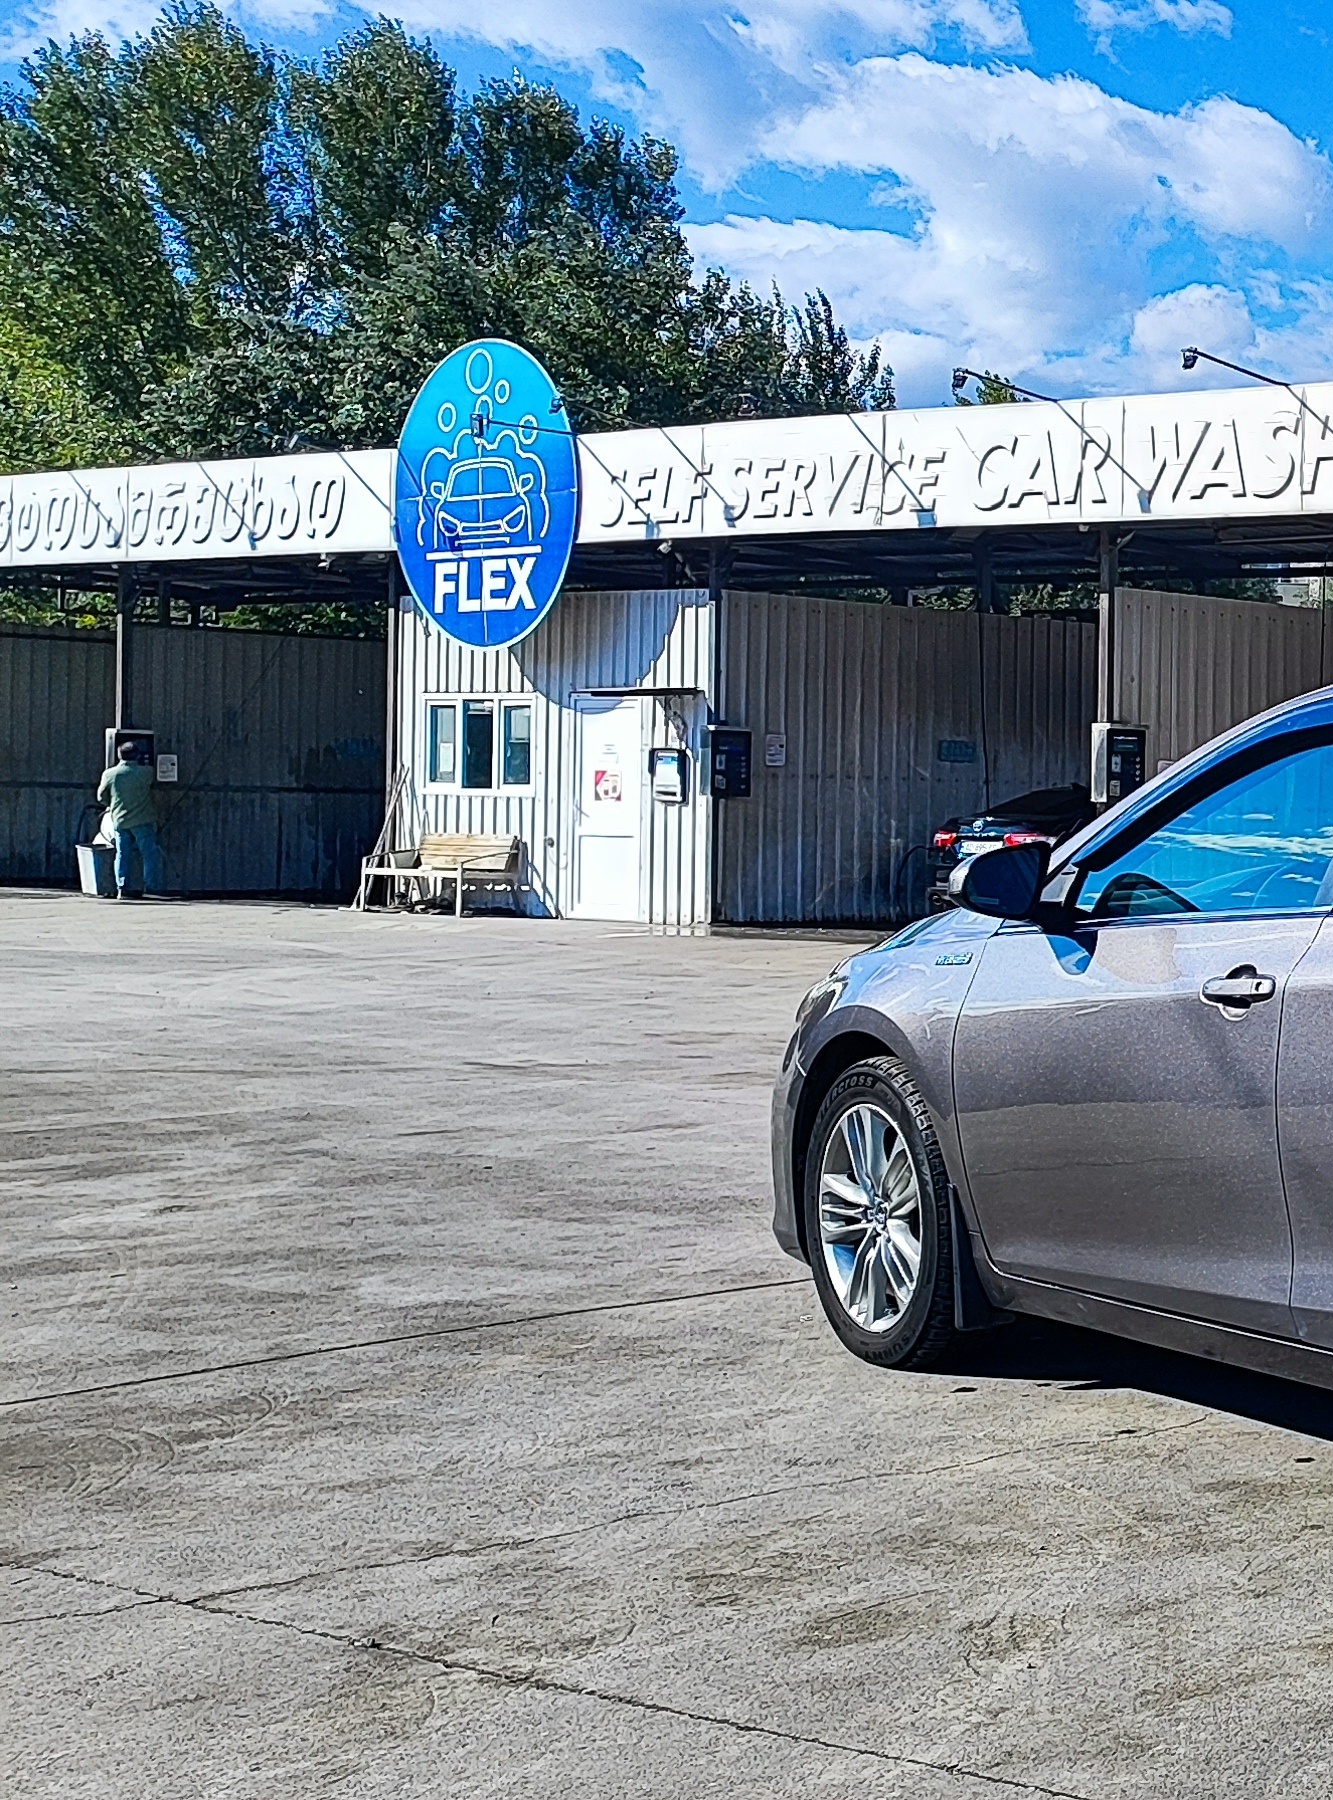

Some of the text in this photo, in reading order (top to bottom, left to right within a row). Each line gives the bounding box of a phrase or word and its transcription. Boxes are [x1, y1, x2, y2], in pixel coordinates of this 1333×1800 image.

[597, 461, 714, 528] SELF
[726, 448, 948, 523] SERVICE
[966, 426, 1113, 512] CAR
[434, 556, 537, 614] FLEX
